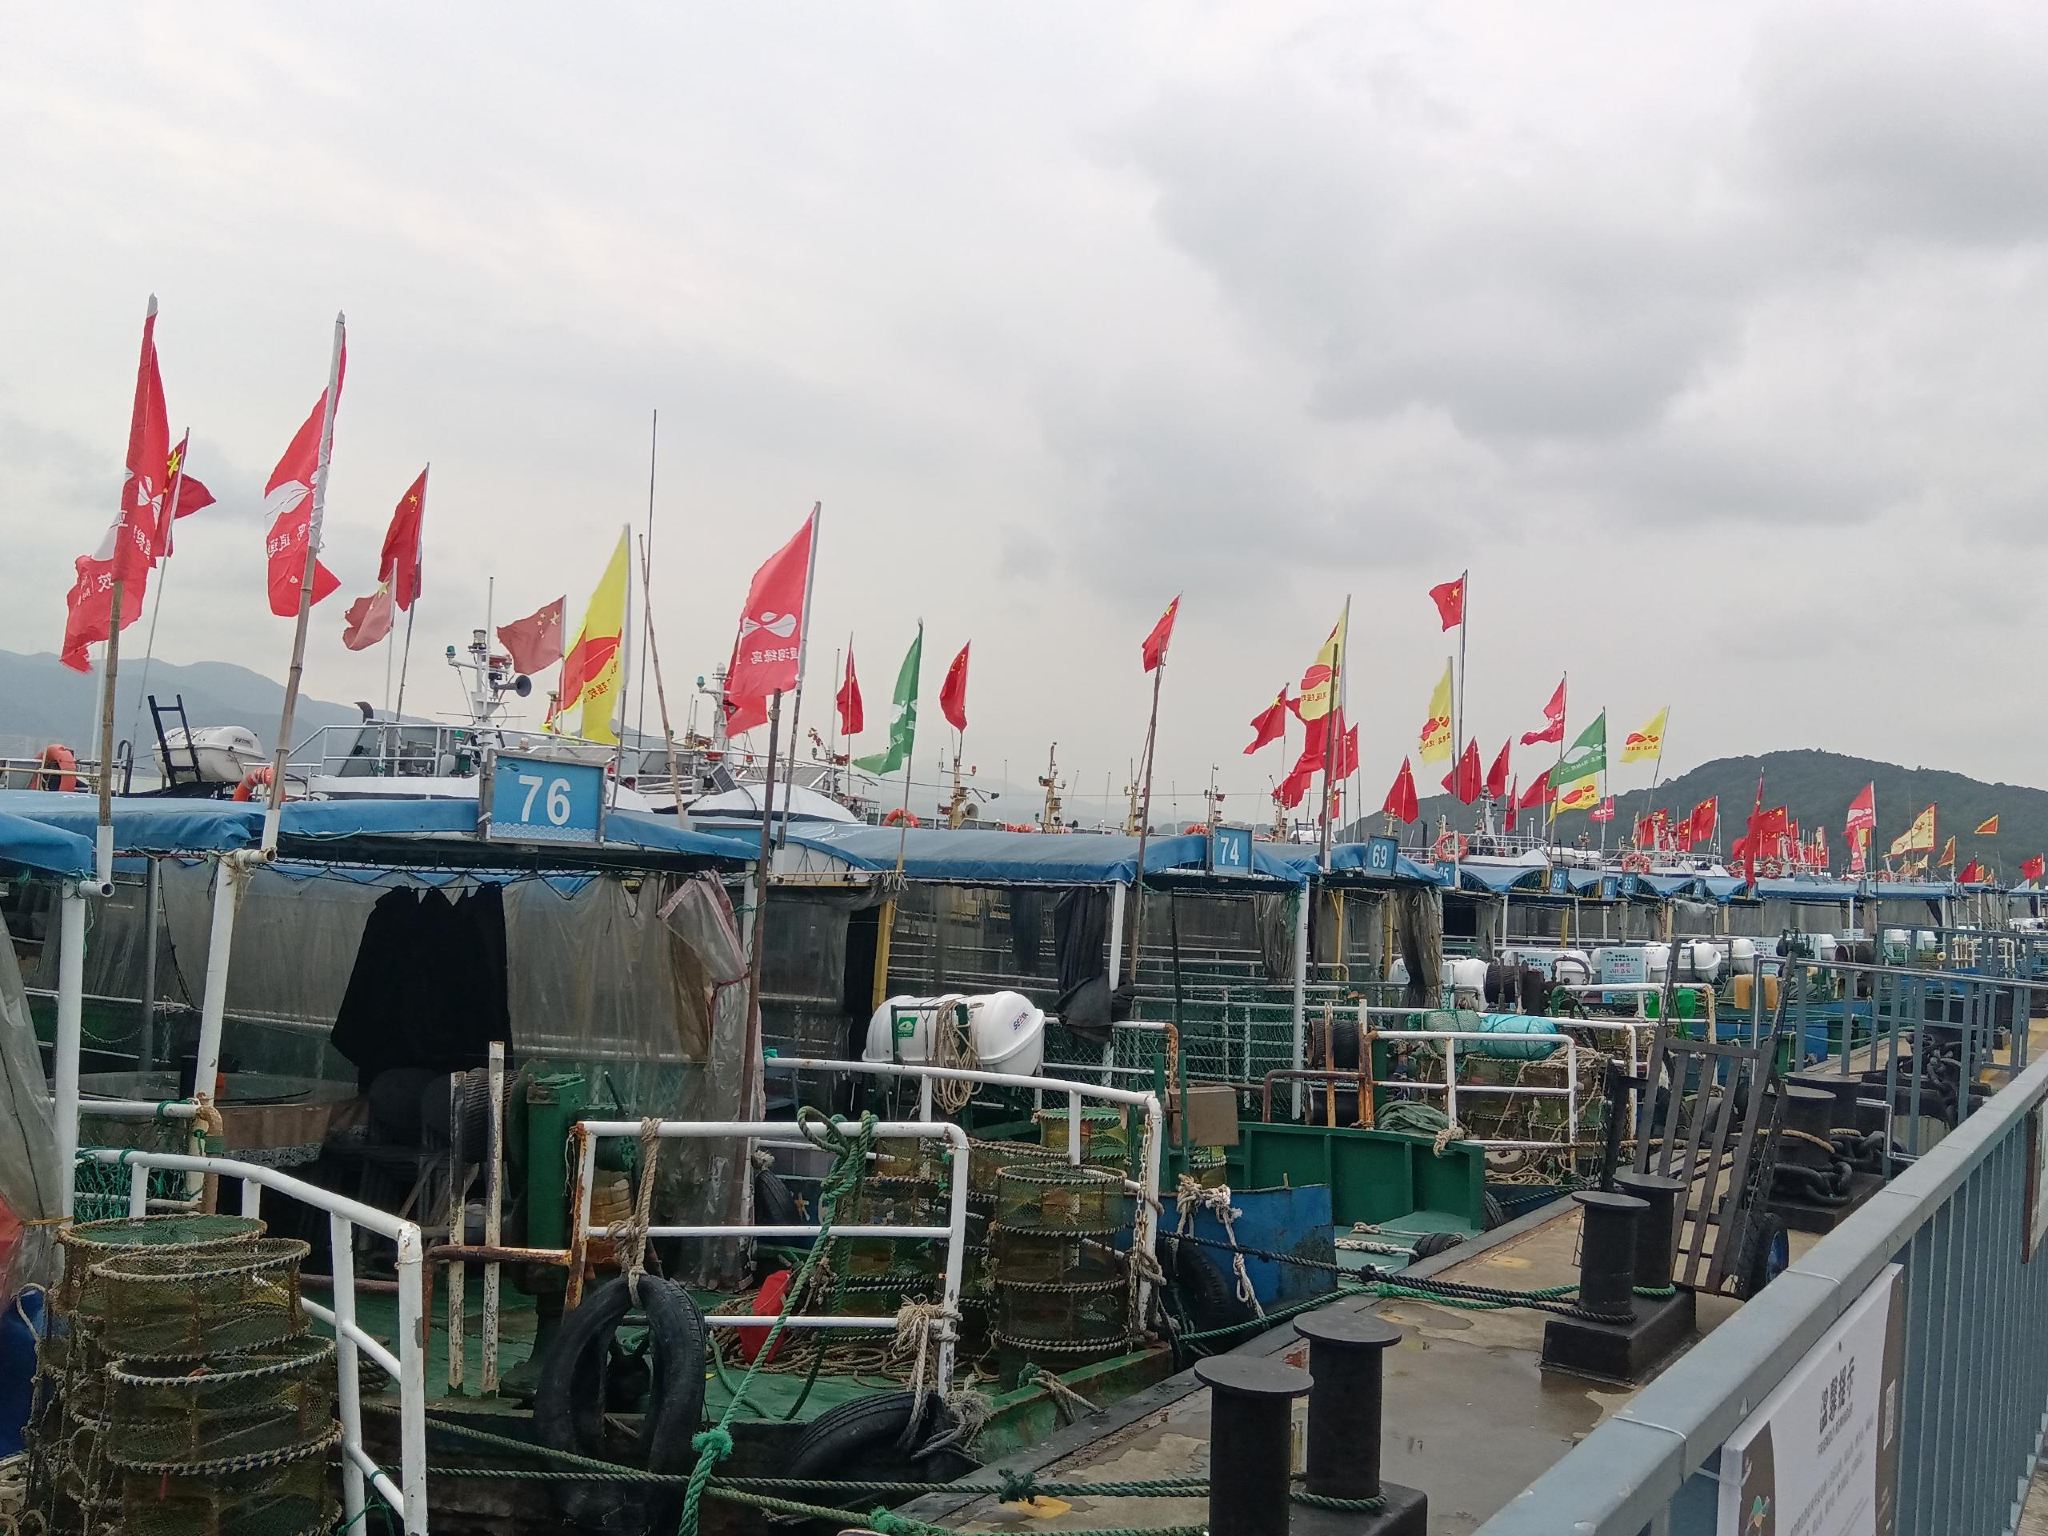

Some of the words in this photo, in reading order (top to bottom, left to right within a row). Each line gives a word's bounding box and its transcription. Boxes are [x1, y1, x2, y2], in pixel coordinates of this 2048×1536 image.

[518, 776, 571, 825] 76
[1220, 837, 1240, 864] 74
[1373, 845, 1387, 867] 69
[1553, 873, 1562, 887] 35
